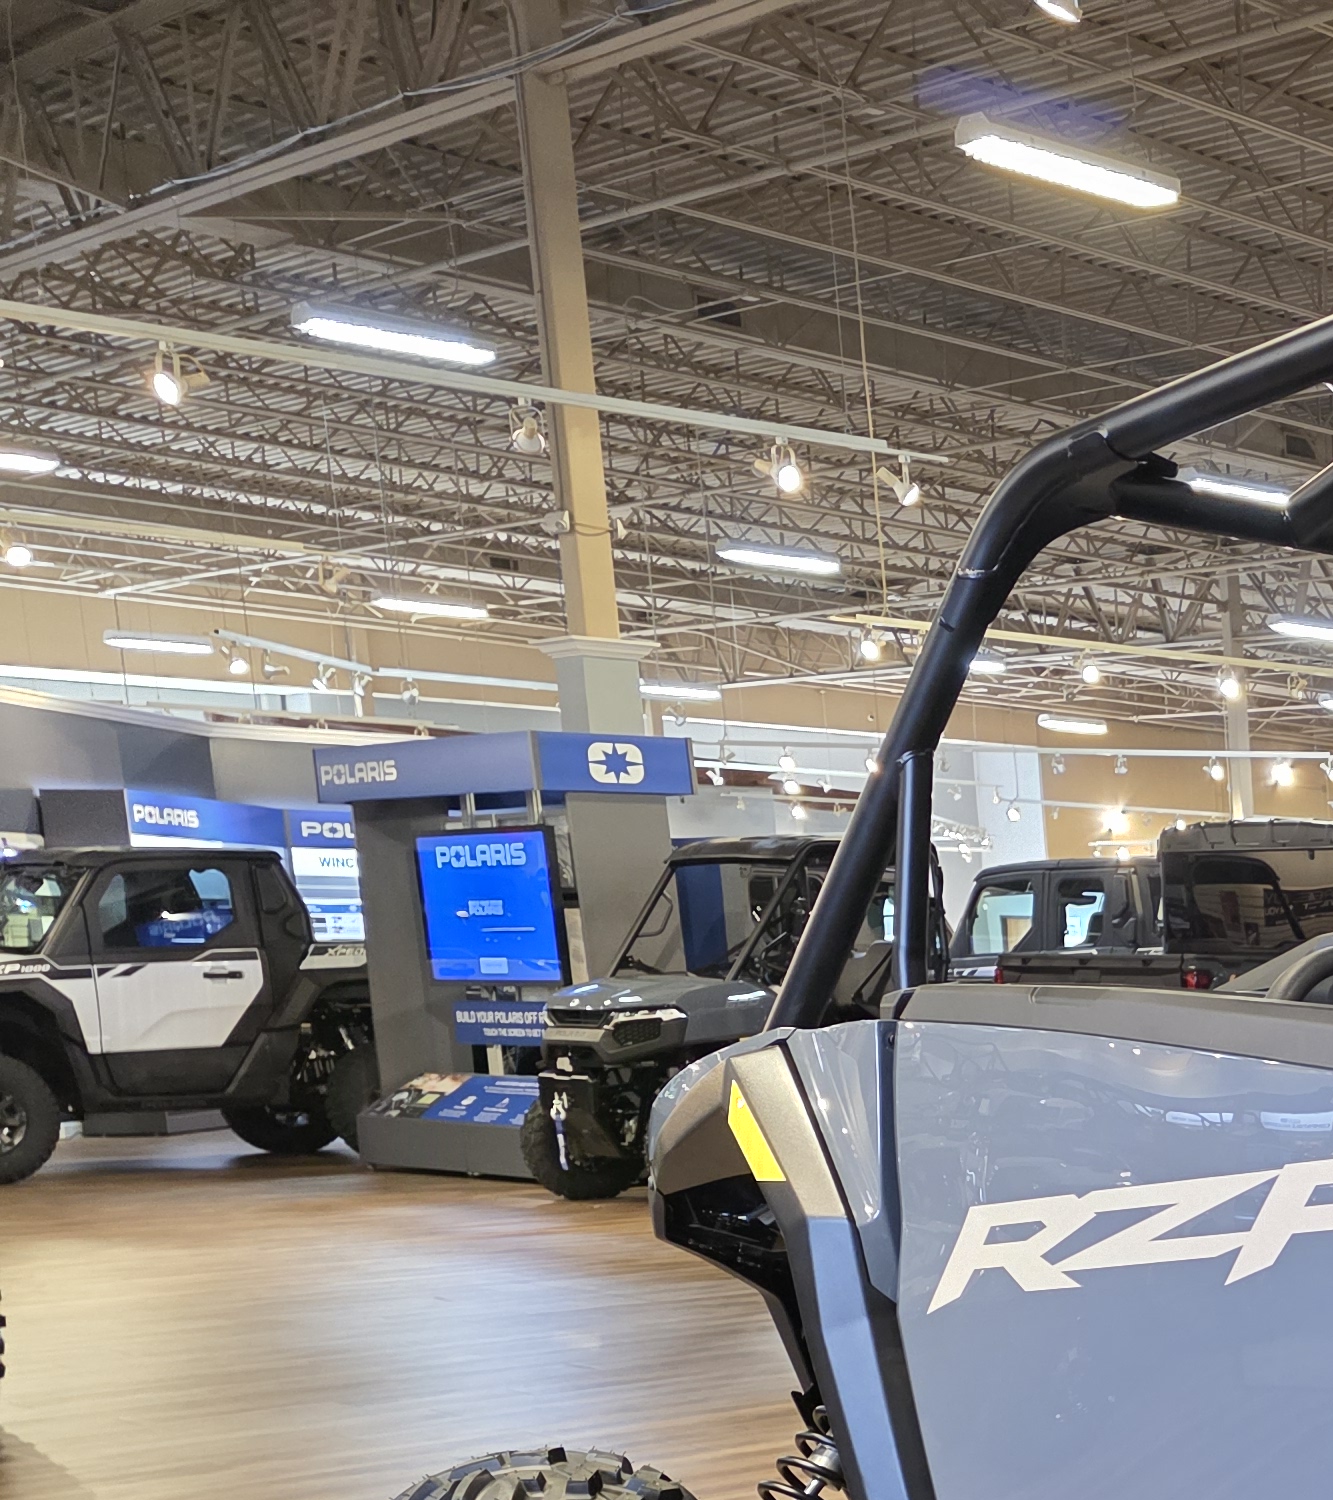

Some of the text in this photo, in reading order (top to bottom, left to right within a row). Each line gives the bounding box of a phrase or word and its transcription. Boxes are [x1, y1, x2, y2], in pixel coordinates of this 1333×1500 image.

[320, 759, 398, 786] POLARIS
[132, 803, 200, 829] POLARIS
[435, 842, 527, 869] POLARIS
[20, 963, 50, 974] 1000
[456, 1010, 476, 1024] BUILD
[476, 1011, 494, 1024] YOUR
[495, 1011, 524, 1025] POLARIS
[524, 1011, 538, 1025] OFF
